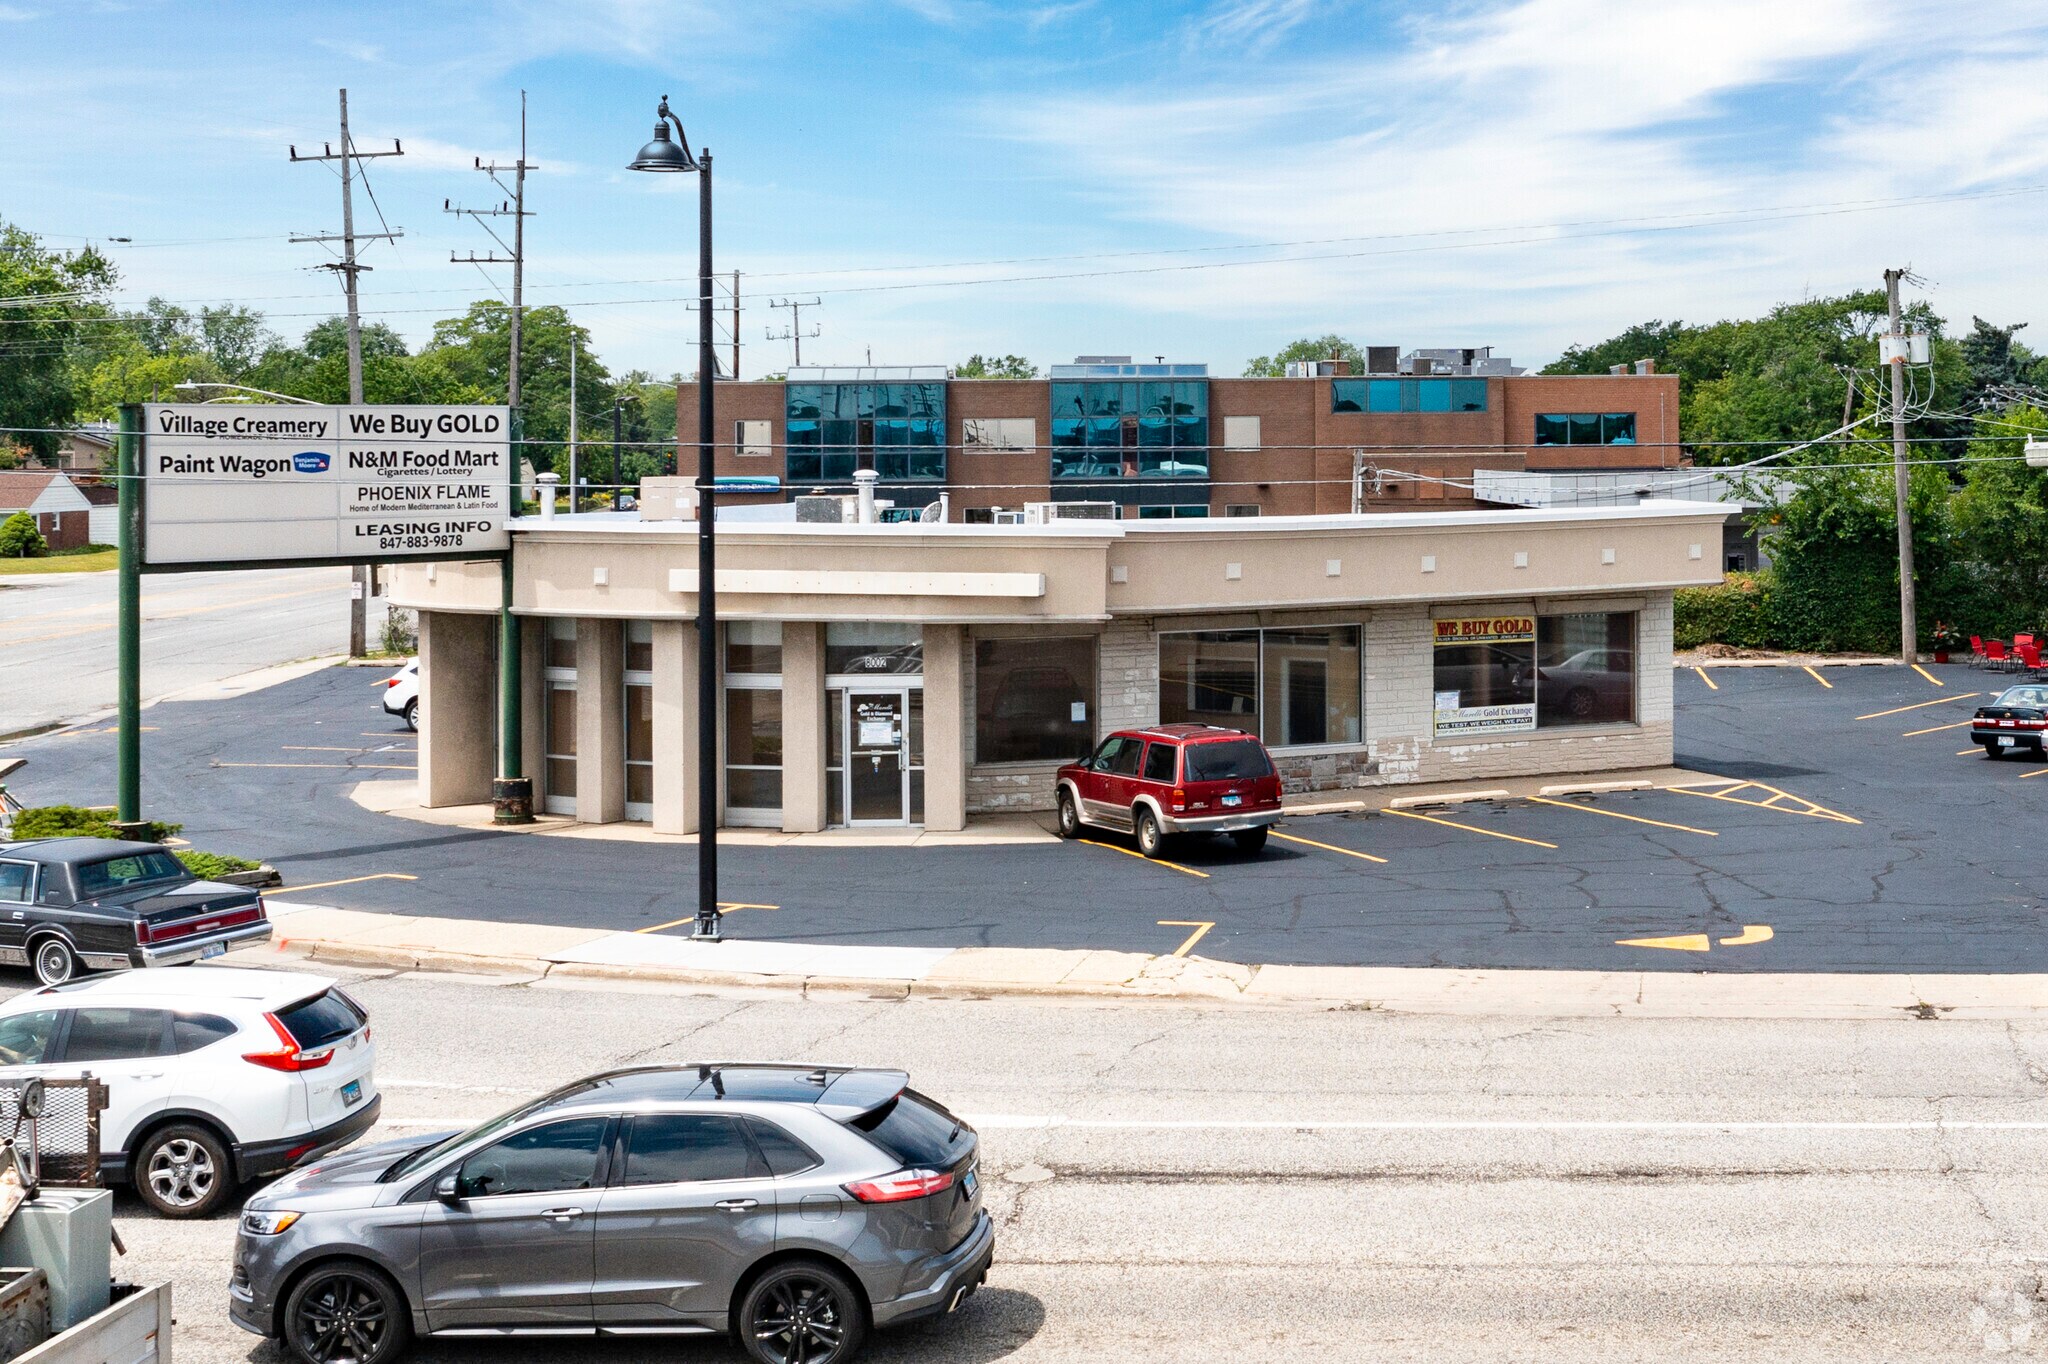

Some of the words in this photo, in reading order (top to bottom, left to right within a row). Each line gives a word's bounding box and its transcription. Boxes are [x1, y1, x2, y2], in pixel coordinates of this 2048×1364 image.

[159, 414, 228, 438] Village
[233, 416, 328, 438] Creamery
[349, 414, 385, 434] We
[391, 414, 433, 438] Buy
[437, 414, 500, 433] GOLD
[160, 454, 214, 473] Paint
[220, 456, 290, 478] Wagon
[349, 451, 398, 468] N&M
[403, 449, 450, 468] Food
[454, 450, 499, 466] Mart
[377, 467, 430, 478] Cigarettes
[436, 467, 474, 476] Lottery
[358, 486, 432, 501] PHOENIX
[436, 485, 491, 500] FLAME
[355, 522, 440, 536] LEASING
[445, 521, 492, 533] INFO
[380, 534, 463, 549] 847-883-9878
[1437, 622, 1458, 635] WE
[1462, 620, 1490, 634] BUY
[1493, 619, 1533, 633] GOLD
[1484, 708, 1499, 716] Gold
[1501, 707, 1532, 716] Exchange
